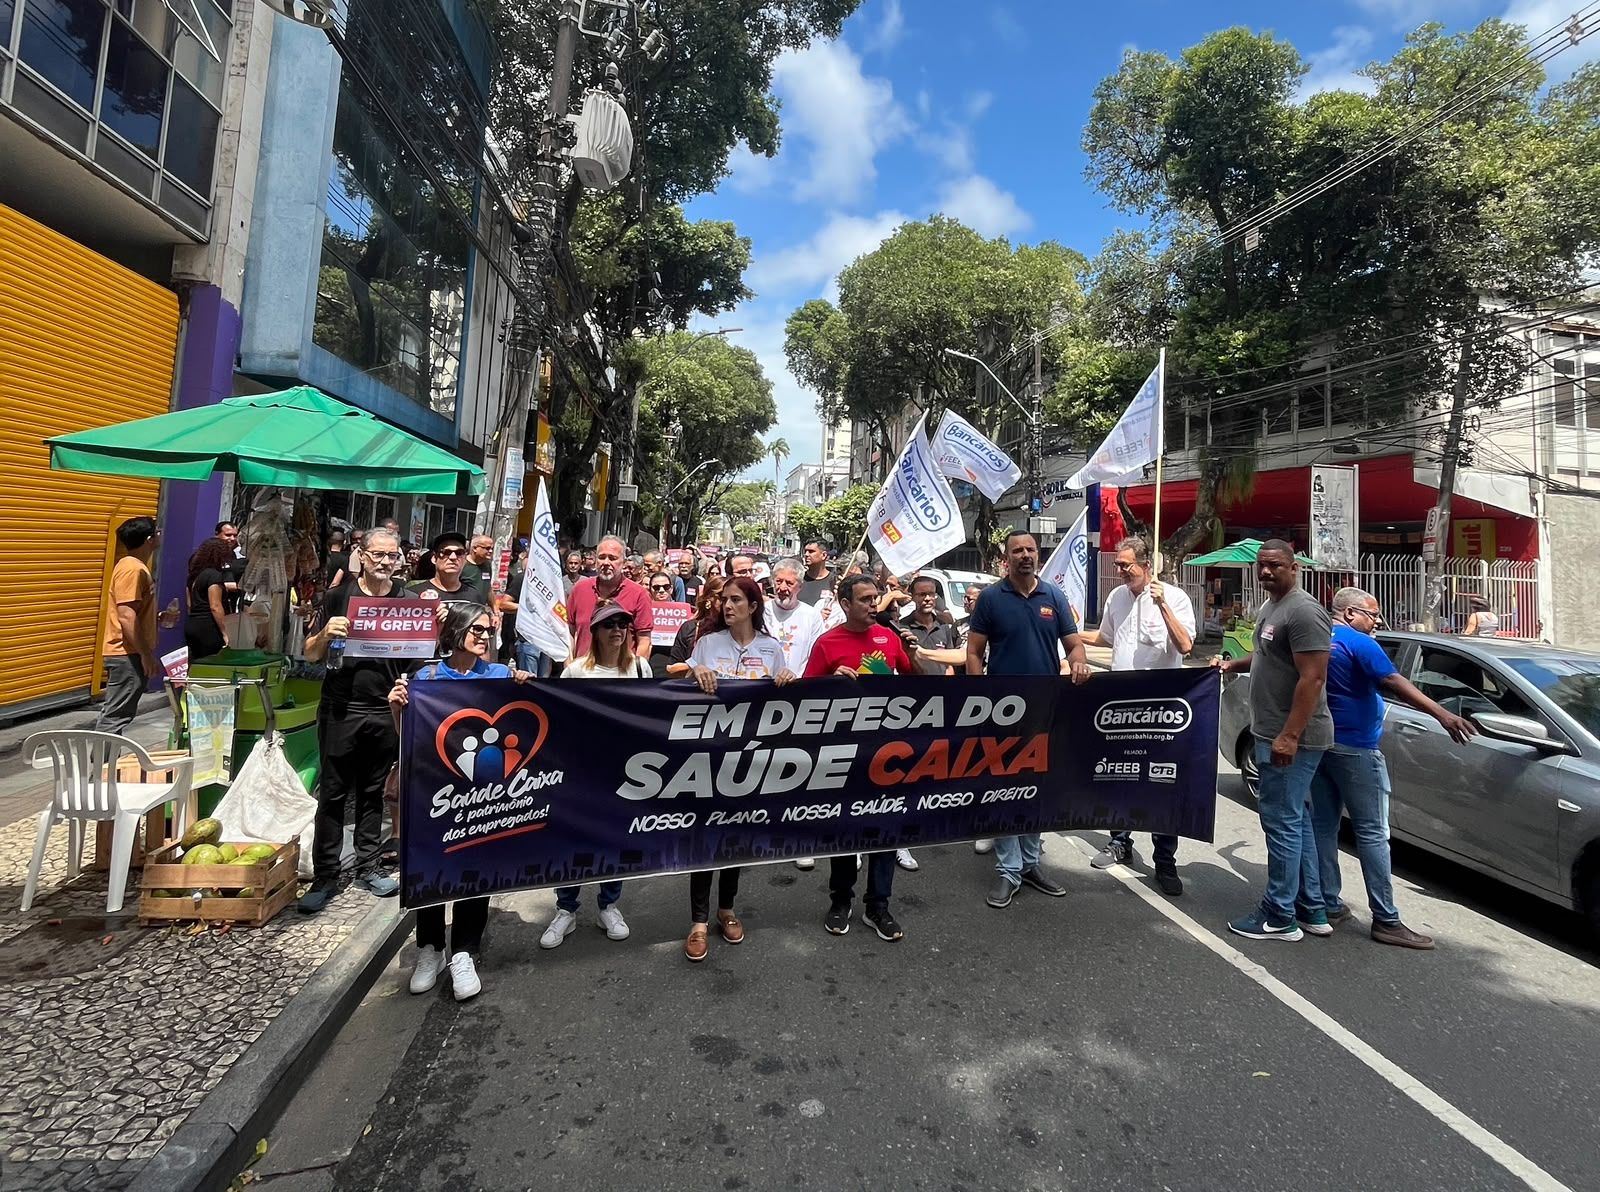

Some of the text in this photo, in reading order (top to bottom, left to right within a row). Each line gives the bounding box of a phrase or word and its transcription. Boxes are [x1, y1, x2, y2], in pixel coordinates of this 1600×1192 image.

[947, 425, 1004, 468] Bancários
[530, 576, 554, 601] FEEB
[357, 606, 433, 618] ESTAMOS
[651, 607, 688, 617] TAMOS
[353, 620, 433, 631] EM GREVE
[668, 694, 1027, 741] EM DEFESA DO
[1100, 706, 1184, 725] Bancários
[1105, 734, 1175, 742] bancariosbahia.org.br
[616, 733, 1049, 801] SAÚDE CAIXA
[1107, 762, 1140, 774] FEEB
[1150, 765, 1175, 775] CTB
[429, 768, 564, 819] Saúde Caixa
[454, 795, 534, 824] é patrimônio
[628, 785, 1038, 834] NOSSO PLANO, NOSSA SAÚDE, NOSSO DIREITO
[442, 804, 550, 844] dos empregados!
